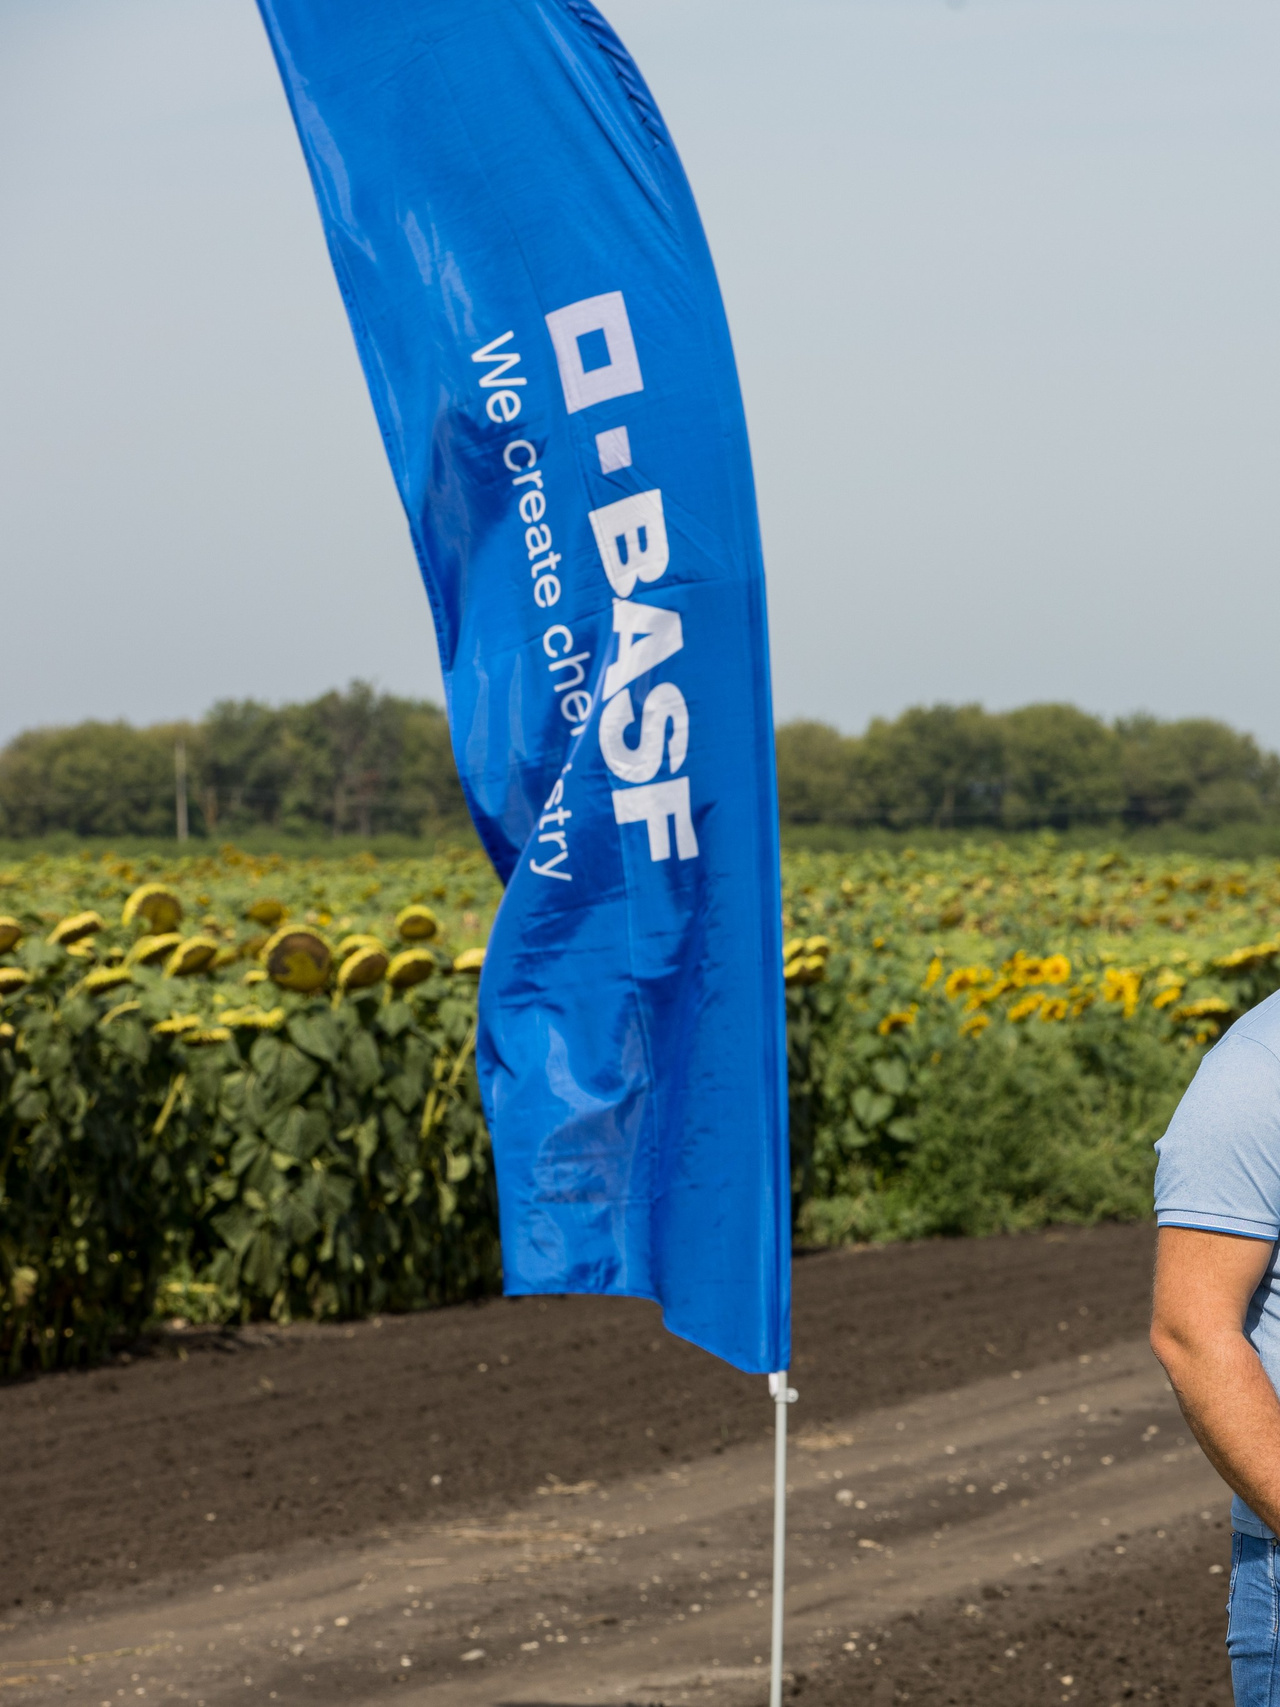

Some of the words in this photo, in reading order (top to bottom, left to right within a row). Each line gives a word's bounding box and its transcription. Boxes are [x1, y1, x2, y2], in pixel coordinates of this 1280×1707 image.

[471, 330, 528, 423] We
[503, 439, 562, 608] create
[529, 624, 593, 882] chestry
[588, 488, 700, 862] BASF
